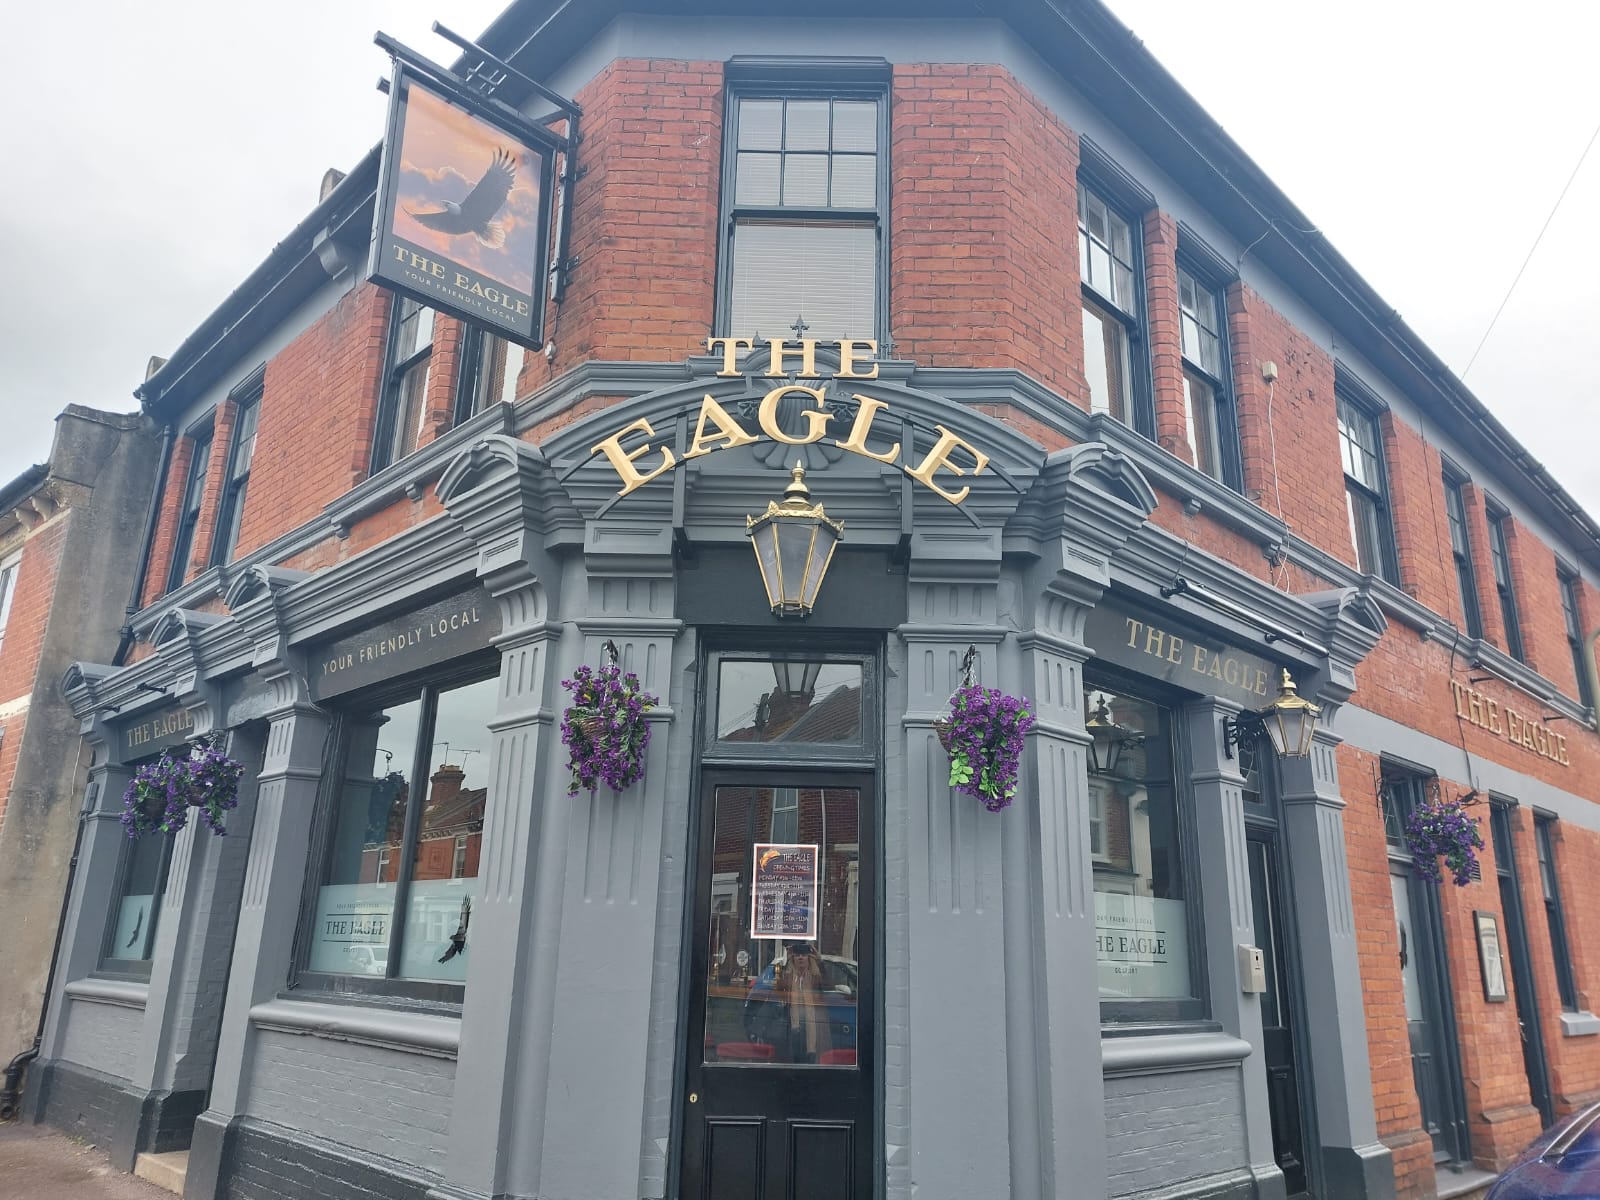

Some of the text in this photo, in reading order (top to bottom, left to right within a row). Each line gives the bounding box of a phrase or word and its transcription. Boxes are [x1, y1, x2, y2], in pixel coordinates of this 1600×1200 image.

[393, 245, 529, 317] THE EAGLE
[404, 270, 517, 322] YOUR FRIENDLY LOCAL
[707, 337, 880, 378] THE
[590, 385, 990, 505] EAGLE
[322, 607, 480, 677] YOUR FRIENDLY LOCAL
[1126, 616, 1269, 697] THE EAGLE
[127, 708, 194, 748] THE EAGLE
[1451, 679, 1570, 767] THE EAGLE
[326, 920, 347, 935] THE
[1118, 936, 1166, 955] EAGLE
